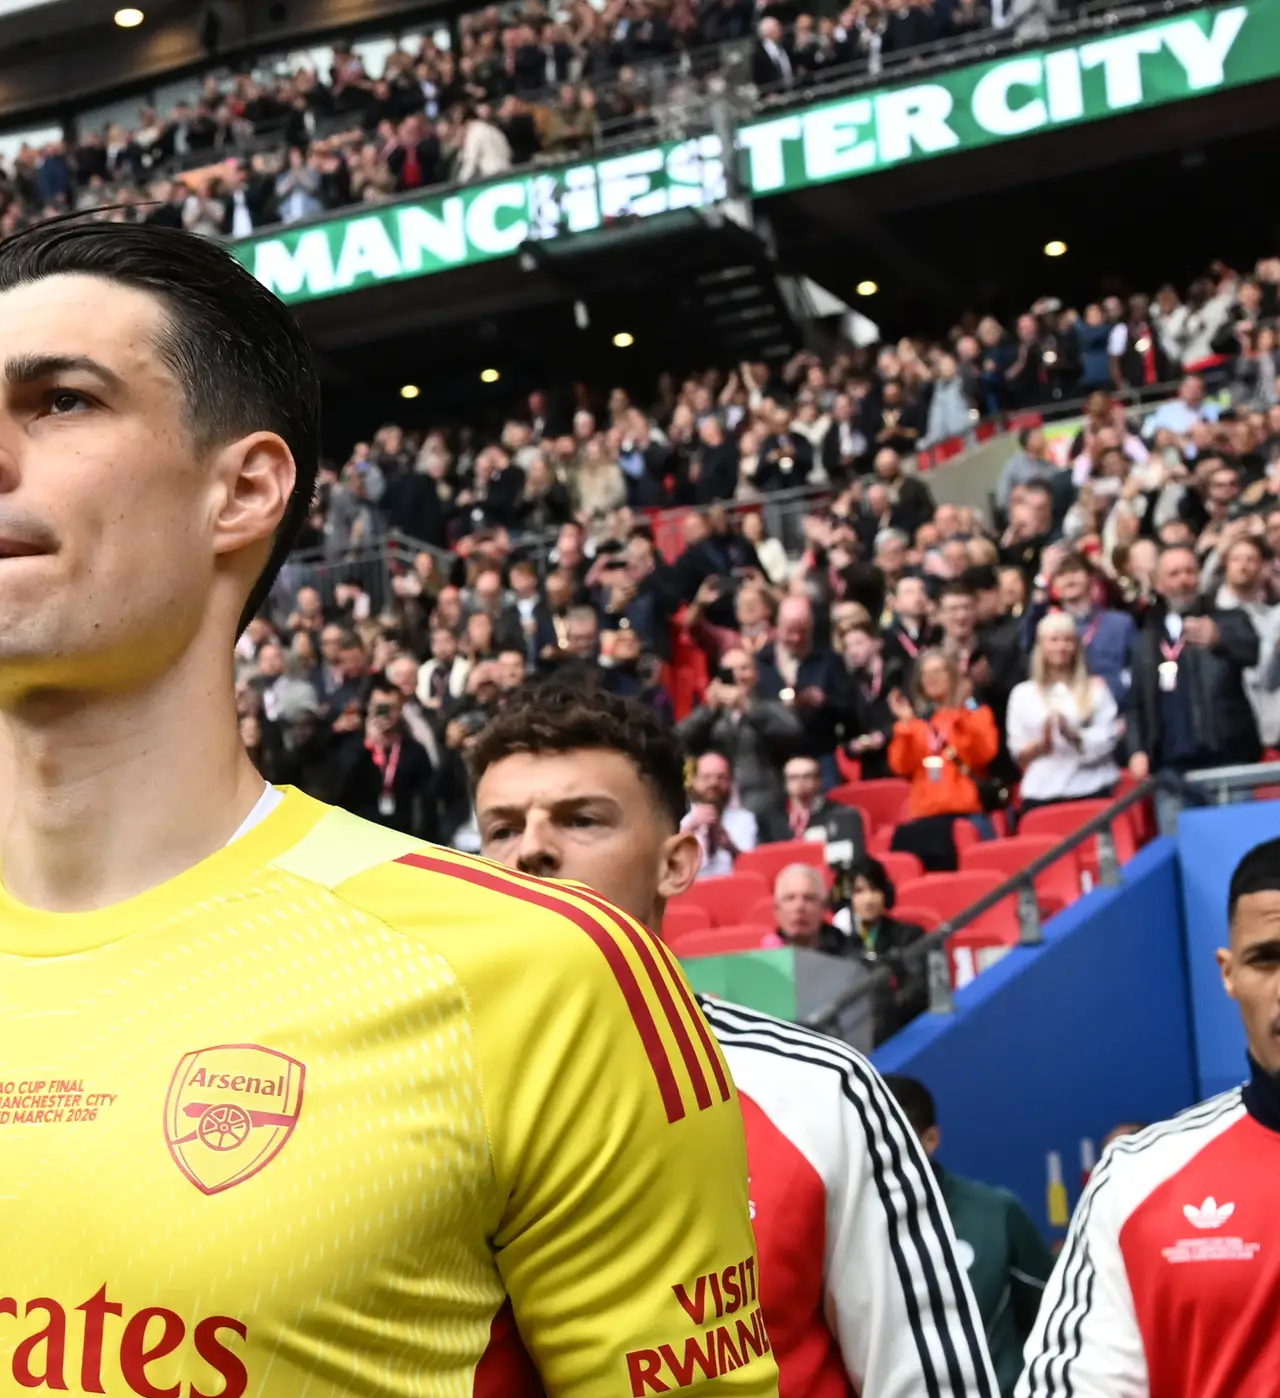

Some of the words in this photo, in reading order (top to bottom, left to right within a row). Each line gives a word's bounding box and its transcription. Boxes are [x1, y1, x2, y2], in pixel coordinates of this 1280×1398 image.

[252, 86, 958, 294] MANCHESTER
[972, 7, 1248, 134] CITY
[17, 1080, 46, 1095] CUP
[47, 1079, 85, 1093] FINAL
[188, 1067, 284, 1097] Arsenal
[85, 1093, 118, 1107] CITY
[11, 1109, 64, 1124] MARCH
[64, 1108, 99, 1123] 2026
[671, 1256, 756, 1326] VISIT
